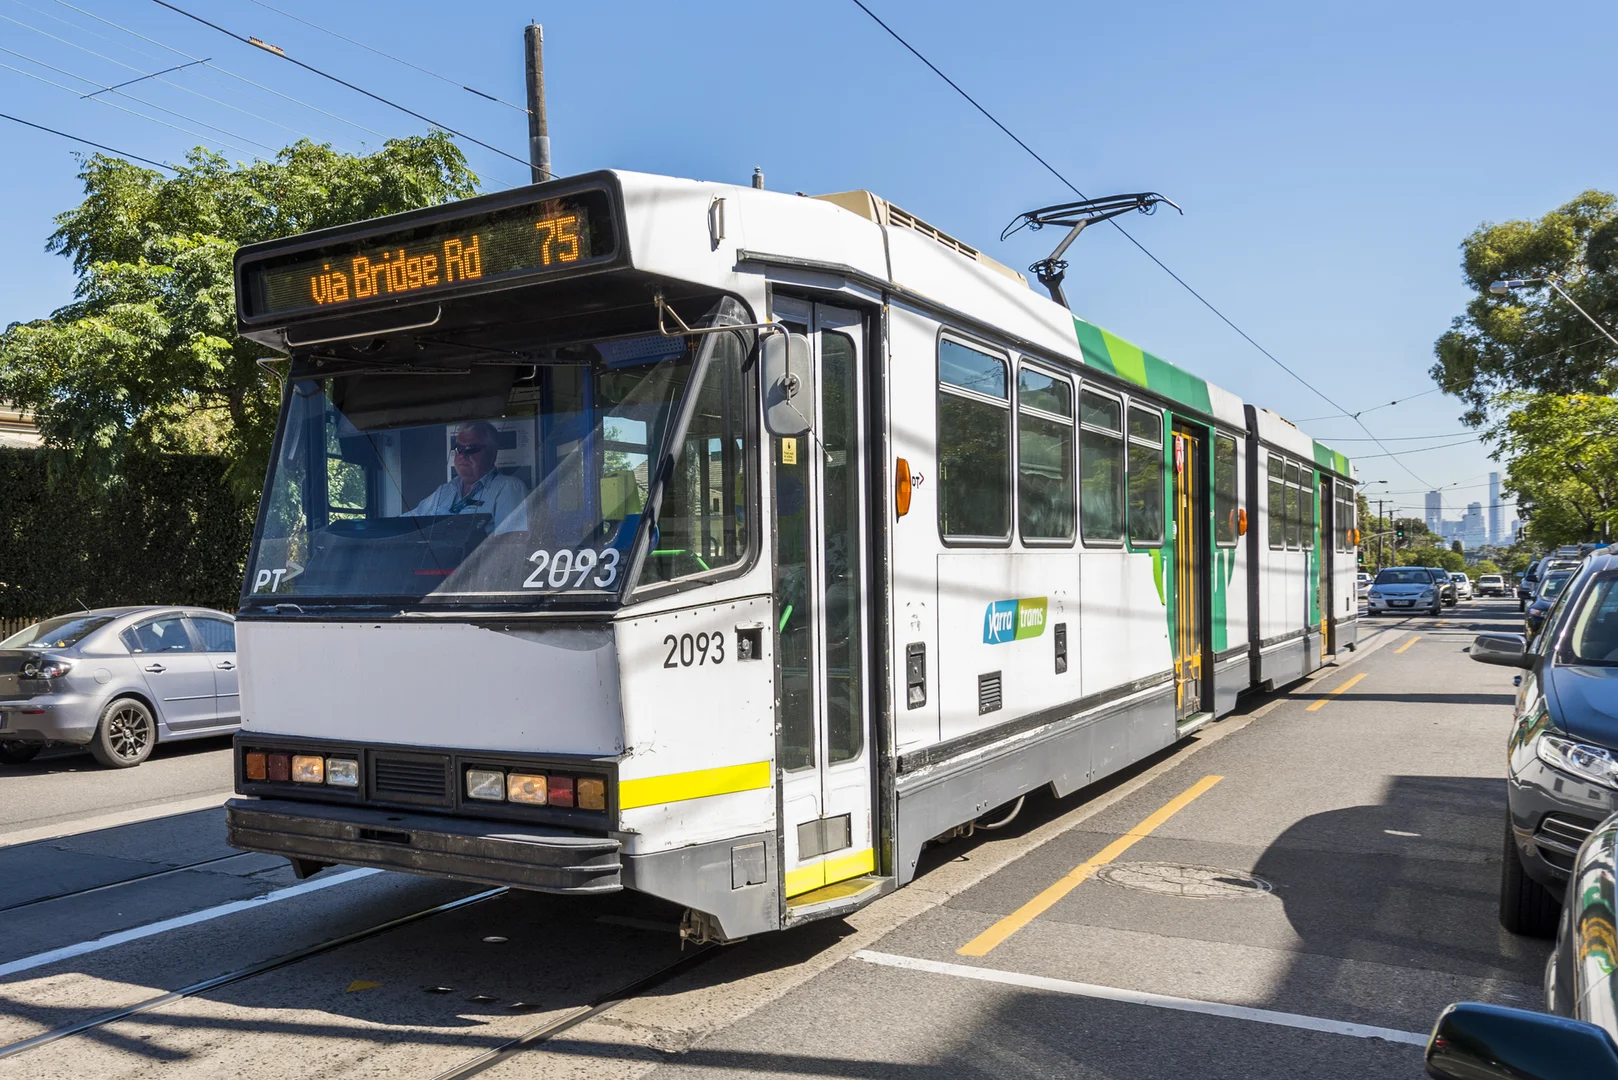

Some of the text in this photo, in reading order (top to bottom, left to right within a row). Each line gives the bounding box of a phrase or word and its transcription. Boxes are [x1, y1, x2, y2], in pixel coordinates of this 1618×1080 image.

[535, 215, 579, 266] 75
[311, 235, 482, 305] via Bridge Rd
[523, 547, 620, 588] 2093
[1020, 605, 1044, 628] trams
[663, 631, 725, 669] 2093
